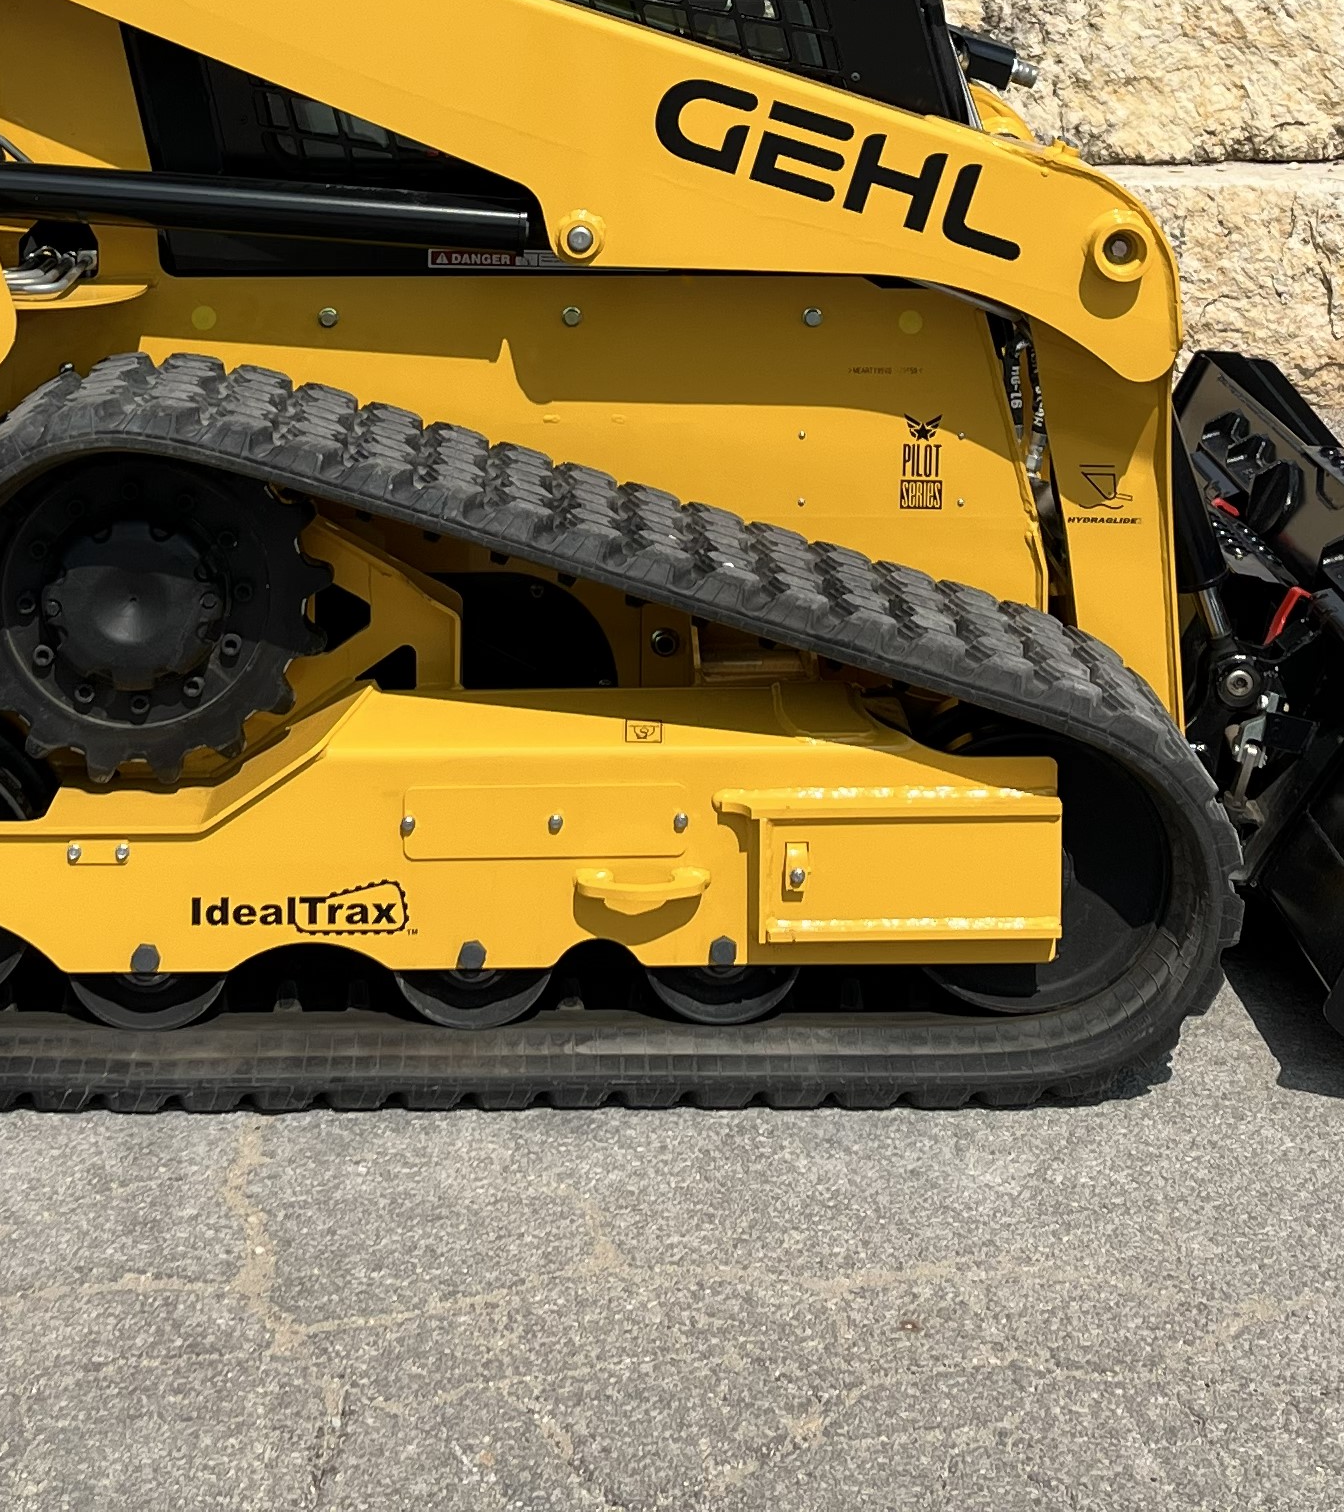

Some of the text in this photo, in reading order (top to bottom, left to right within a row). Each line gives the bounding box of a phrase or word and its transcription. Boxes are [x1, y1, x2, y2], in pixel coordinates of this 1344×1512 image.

[655, 78, 1021, 261] GEHL
[451, 253, 511, 265] DANGER
[902, 444, 943, 478] PILOT
[1067, 516, 1139, 525] HYDRAGLIDE
[191, 896, 398, 926] IdealTrax
